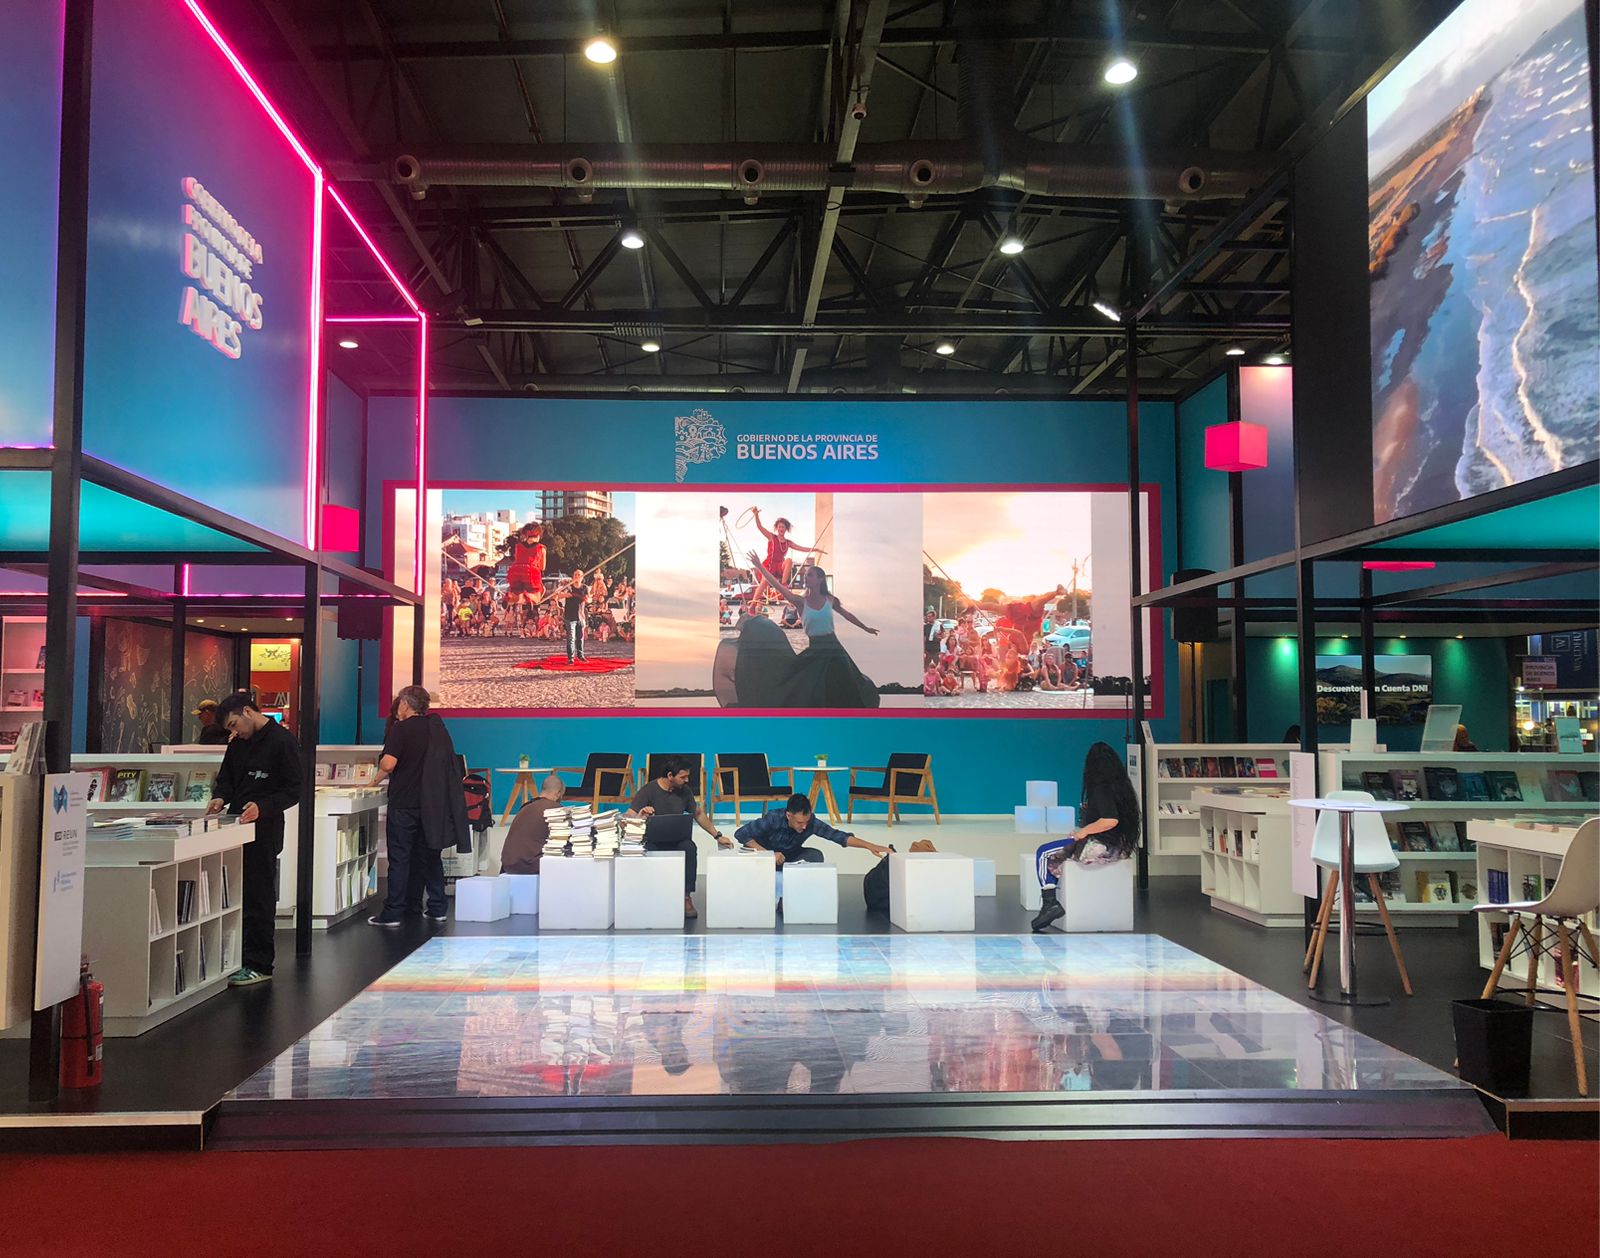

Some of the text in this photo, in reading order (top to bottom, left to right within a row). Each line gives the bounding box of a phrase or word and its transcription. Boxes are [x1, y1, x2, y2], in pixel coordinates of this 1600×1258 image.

[182, 232, 263, 330] BUENOS
[180, 286, 242, 360] AIRES
[737, 434, 878, 442] GOBIERNO DE LA PROVINCIA DE
[736, 444, 879, 460] BUENOS AIRES
[1381, 684, 1410, 693] Cuenta
[1412, 684, 1428, 692] DNI
[117, 771, 137, 779] PITY
